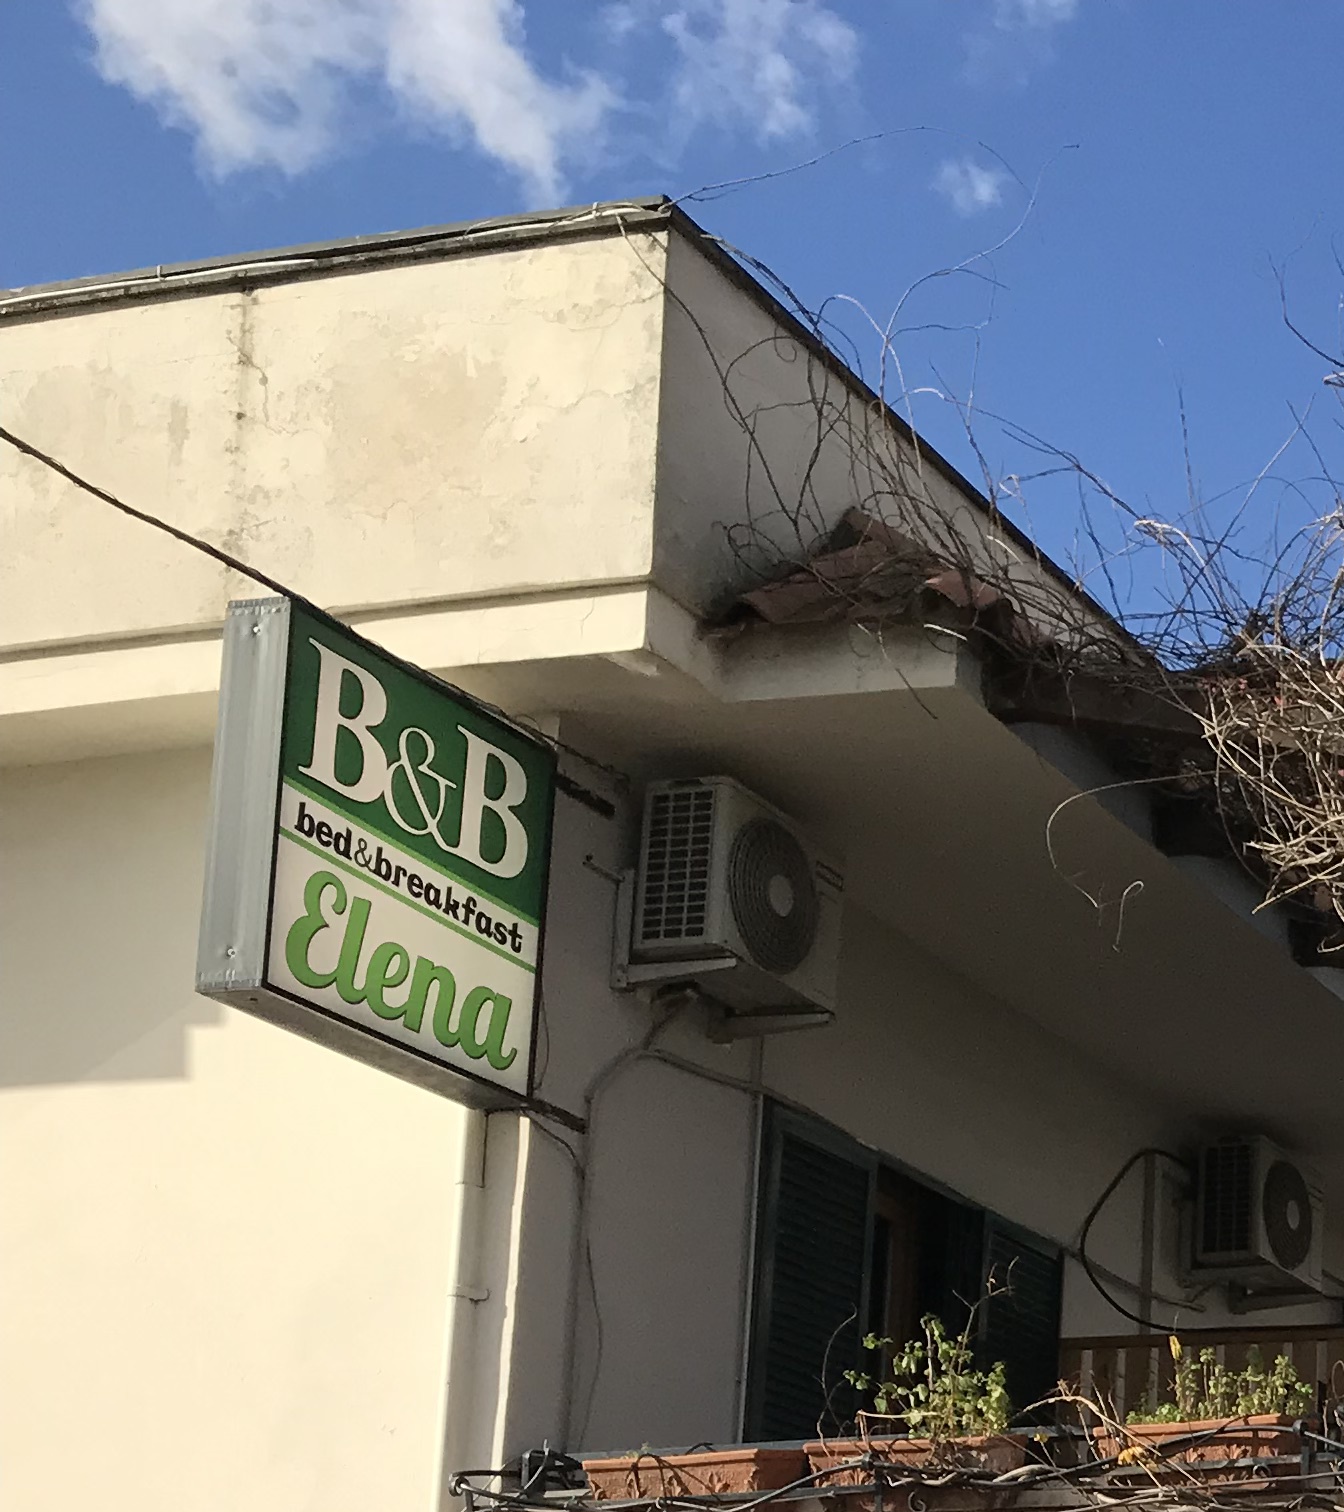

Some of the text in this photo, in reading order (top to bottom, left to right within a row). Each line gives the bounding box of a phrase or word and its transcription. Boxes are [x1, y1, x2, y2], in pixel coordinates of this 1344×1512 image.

[297, 637, 528, 879] B&B
[285, 870, 517, 1071] Elena
[294, 801, 523, 954] bed&breakfast
